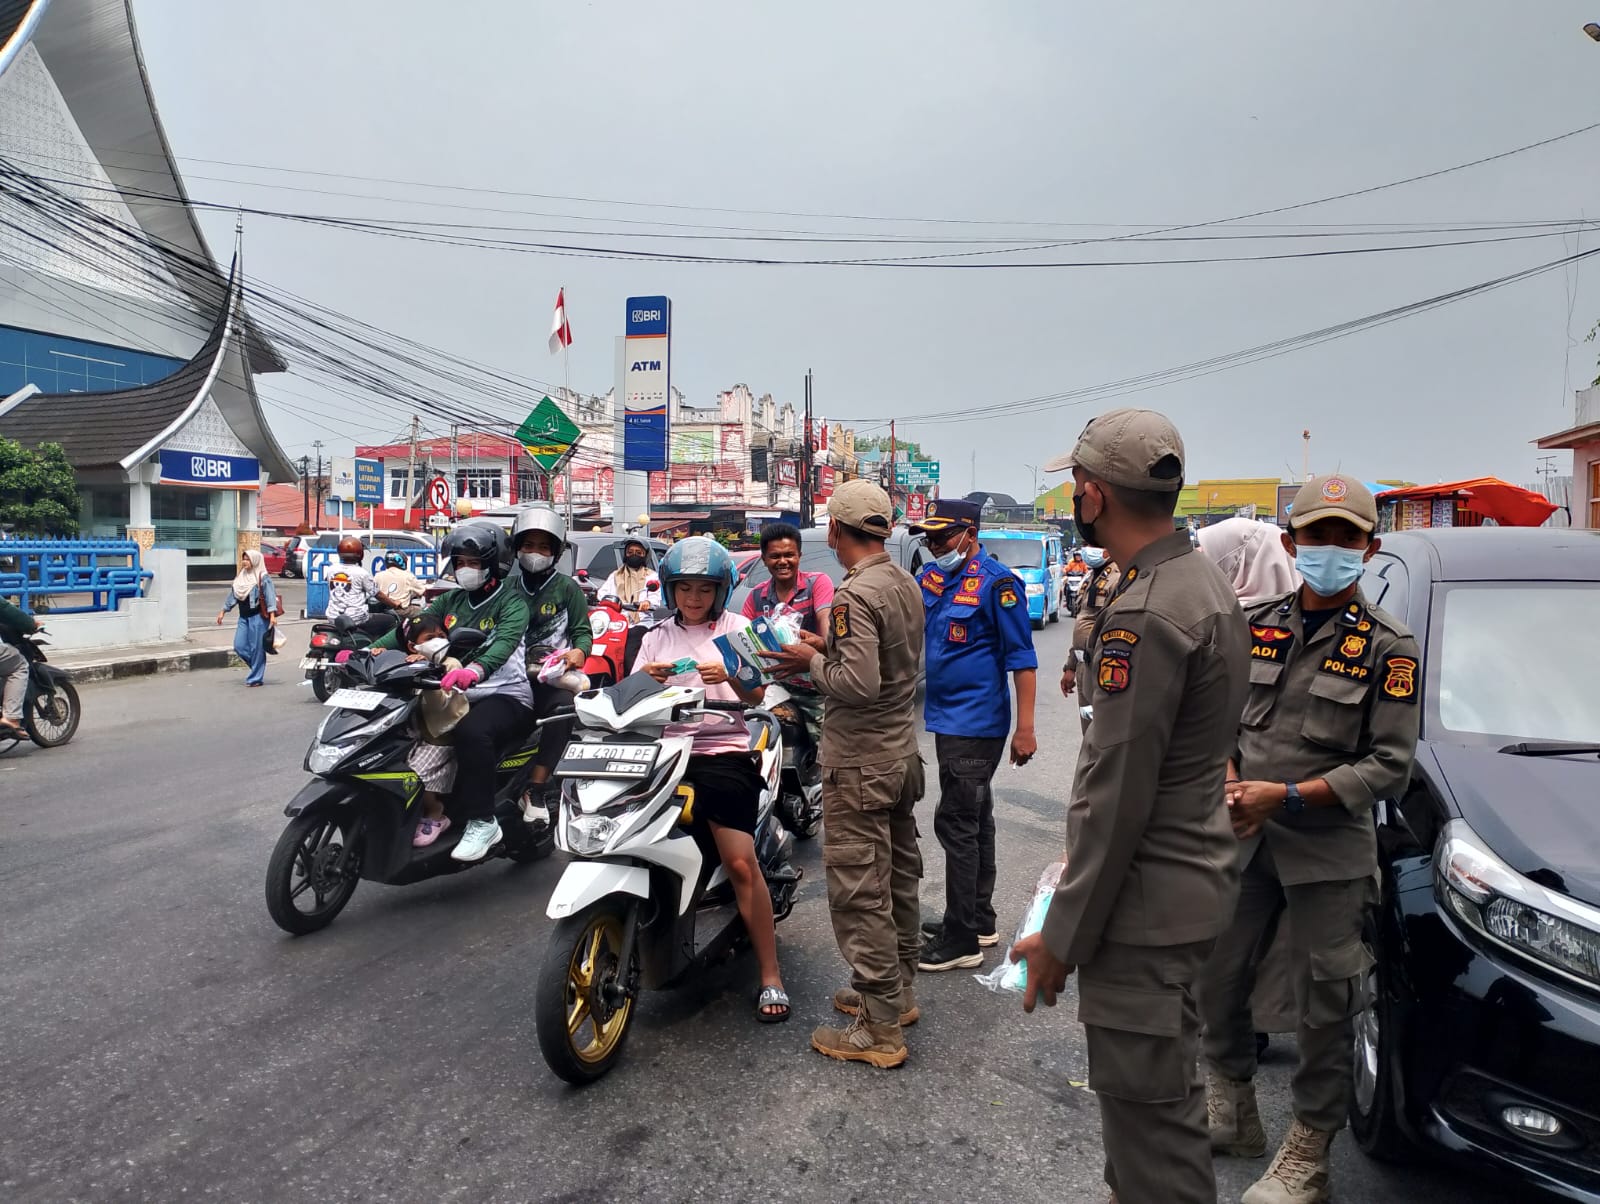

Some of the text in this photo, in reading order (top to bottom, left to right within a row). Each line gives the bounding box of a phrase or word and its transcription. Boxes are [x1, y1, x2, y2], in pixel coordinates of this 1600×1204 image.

[643, 310, 661, 321] BRI
[631, 360, 662, 372] ATM
[206, 459, 231, 478] BRI
[1250, 646, 1278, 659] ADI
[1323, 659, 1368, 679] POL-PP
[567, 747, 584, 760] BA
[593, 748, 626, 760] 4301
